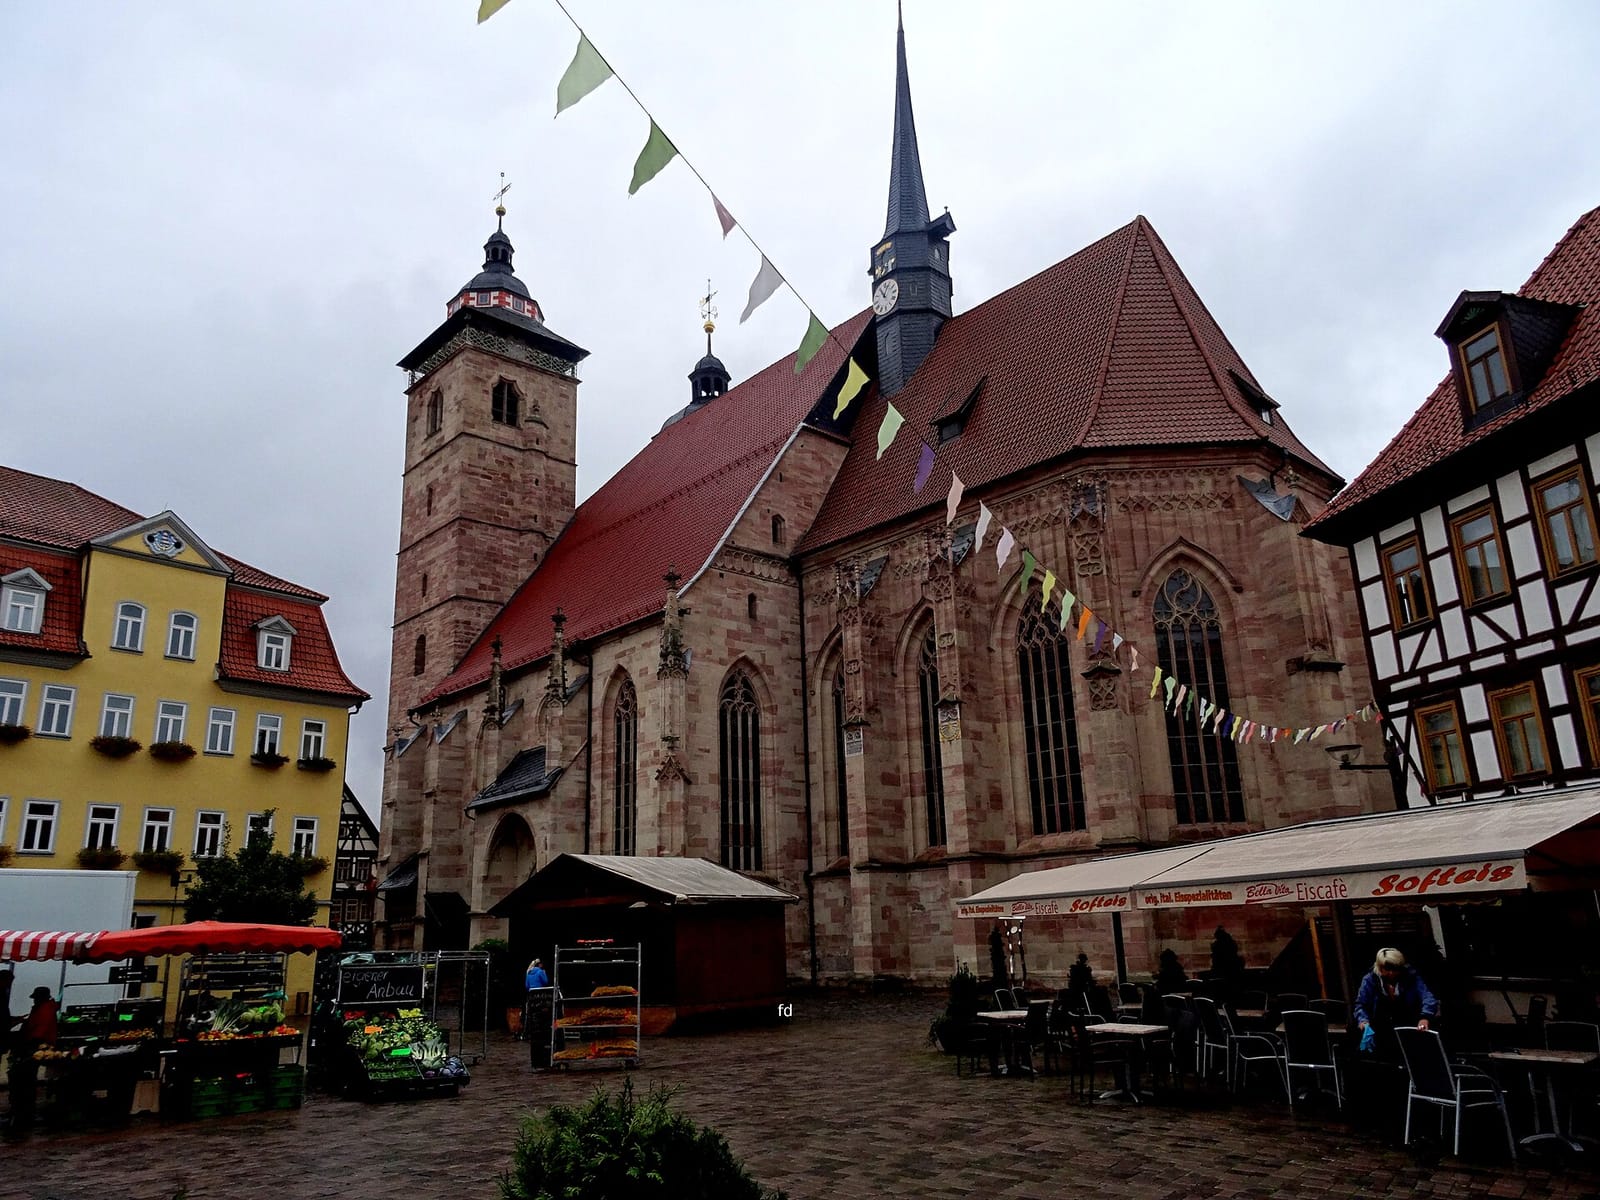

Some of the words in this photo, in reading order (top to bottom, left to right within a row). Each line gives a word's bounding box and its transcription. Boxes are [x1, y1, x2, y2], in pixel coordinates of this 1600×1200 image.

[1371, 863, 1515, 896] Softeis
[1144, 893, 1159, 906] orig.
[1159, 892, 1173, 903] ital.
[1174, 889, 1233, 904] Eisspezialitäten
[1245, 884, 1272, 899] Bella
[1273, 883, 1294, 896] Vita
[1296, 878, 1348, 900] Eiscafè
[1069, 894, 1128, 912] Softeis
[366, 981, 415, 999] Anbau
